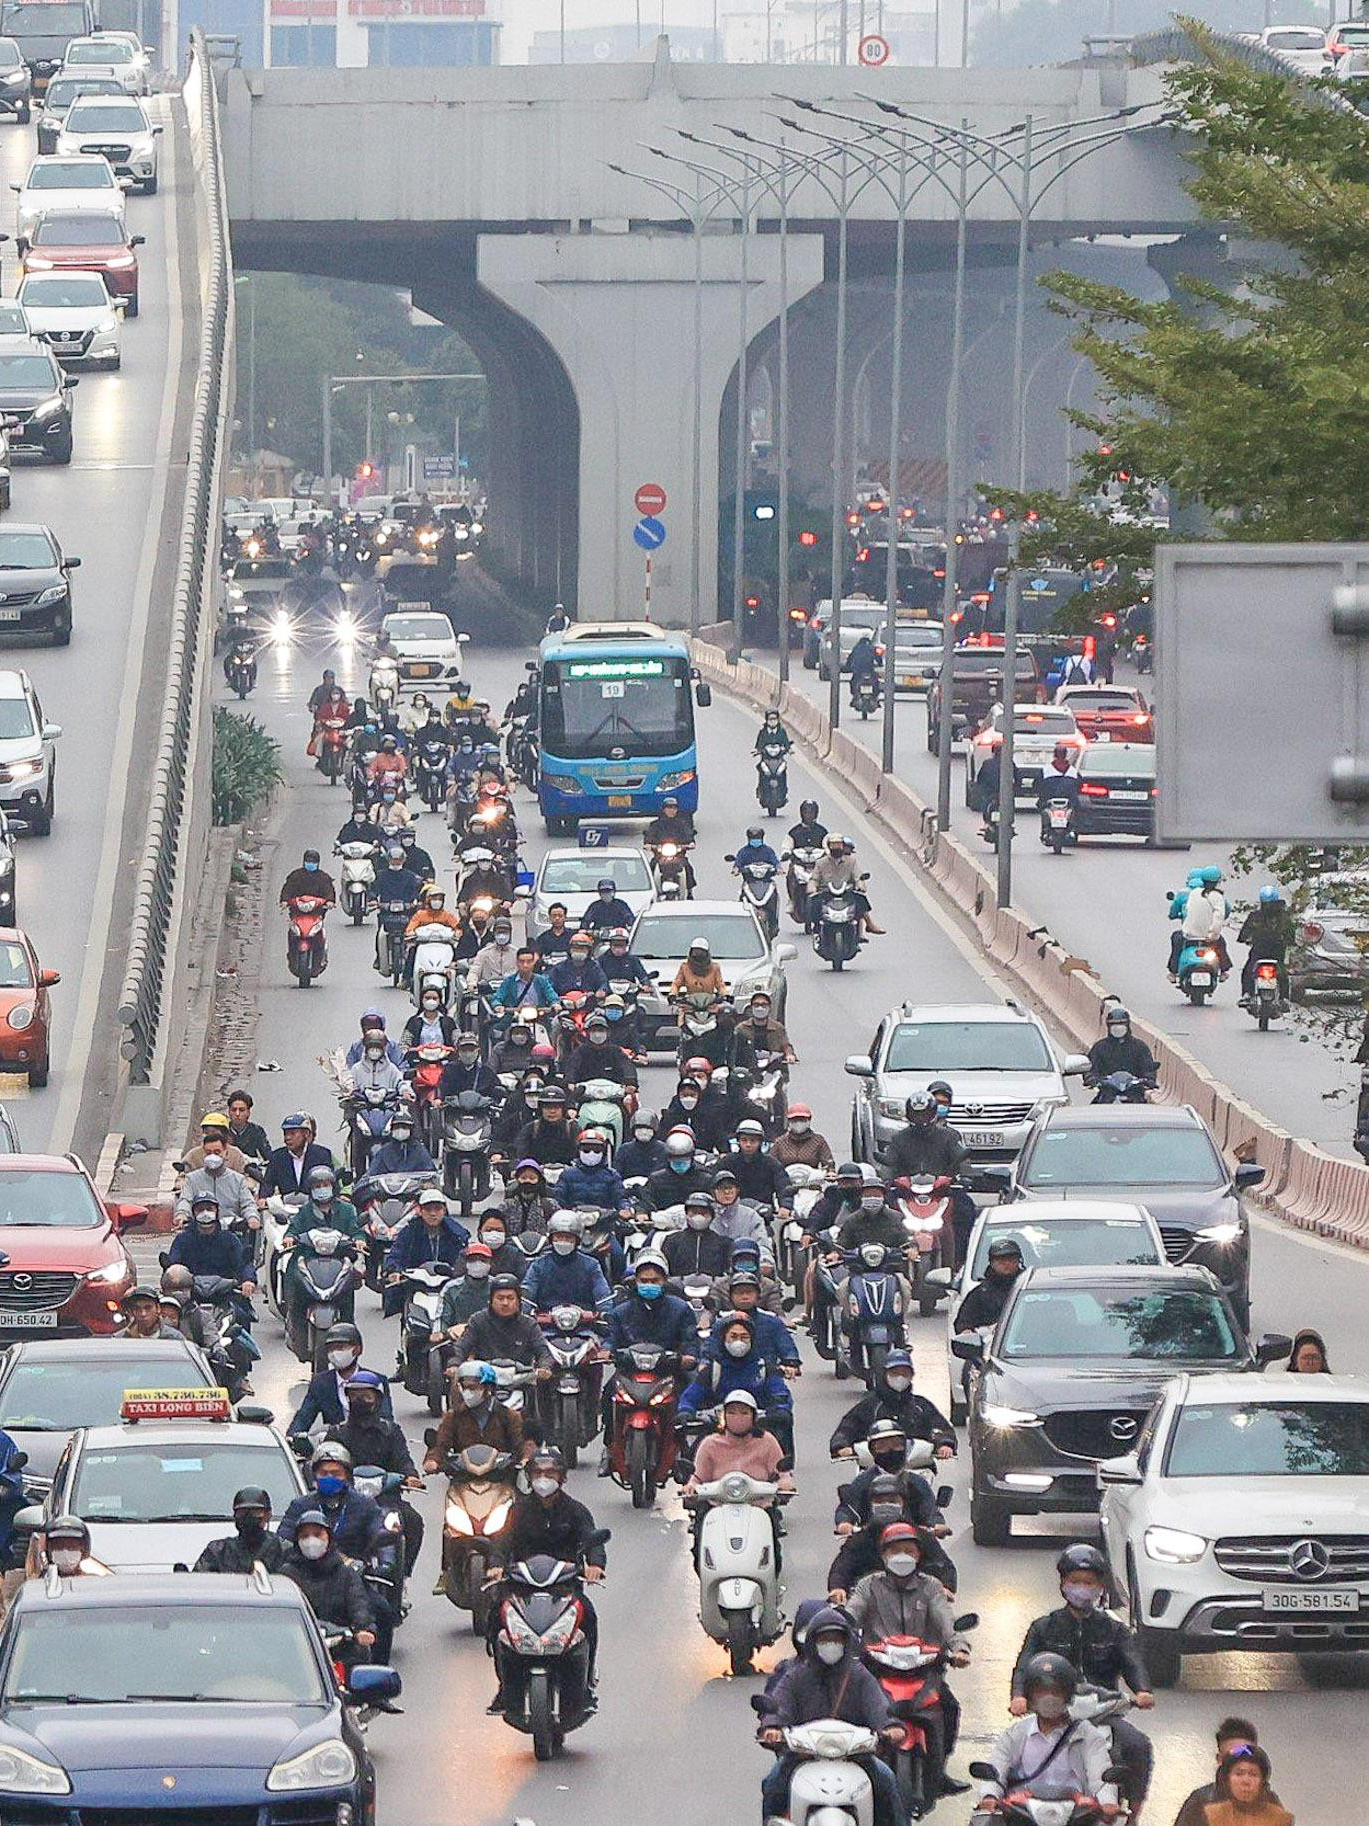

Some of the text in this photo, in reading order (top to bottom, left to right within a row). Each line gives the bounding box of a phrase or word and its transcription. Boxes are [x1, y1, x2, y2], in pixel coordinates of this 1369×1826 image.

[867, 43, 881, 57] 80
[129, 1403, 157, 1413] TAXI
[160, 1402, 193, 1413] LONG
